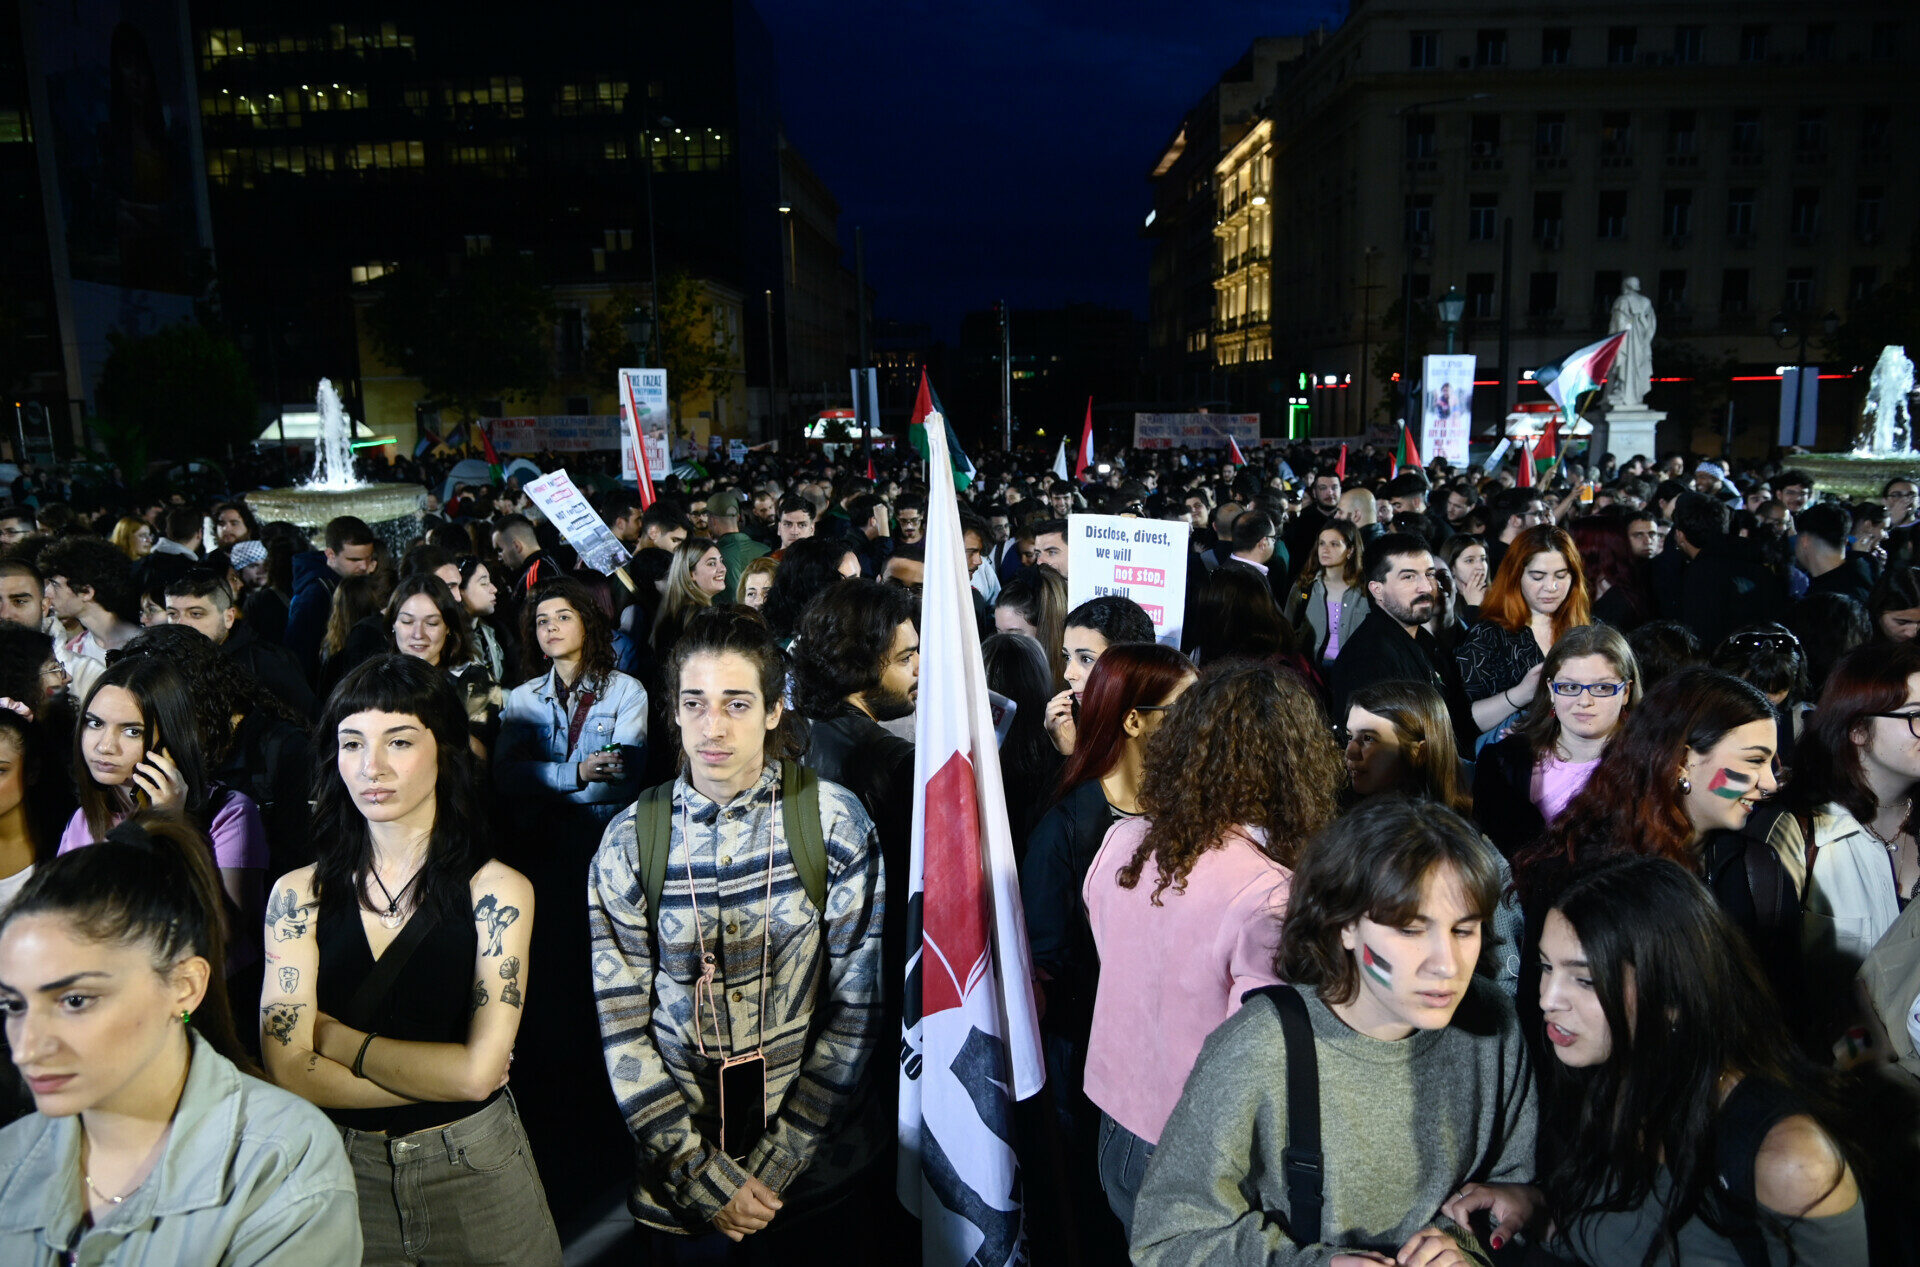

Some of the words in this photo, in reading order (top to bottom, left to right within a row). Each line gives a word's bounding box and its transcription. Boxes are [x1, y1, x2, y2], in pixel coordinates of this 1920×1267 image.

[643, 375, 661, 386] ΓΑΖΑΣ
[1085, 525, 1129, 543] Disclose,
[1134, 530, 1170, 546] divest,
[1096, 547, 1110, 559] we
[1113, 548, 1132, 562] will
[1115, 567, 1133, 581] not
[1137, 570, 1164, 585] stop,
[1094, 585, 1109, 596] we
[1111, 586, 1130, 598] will
